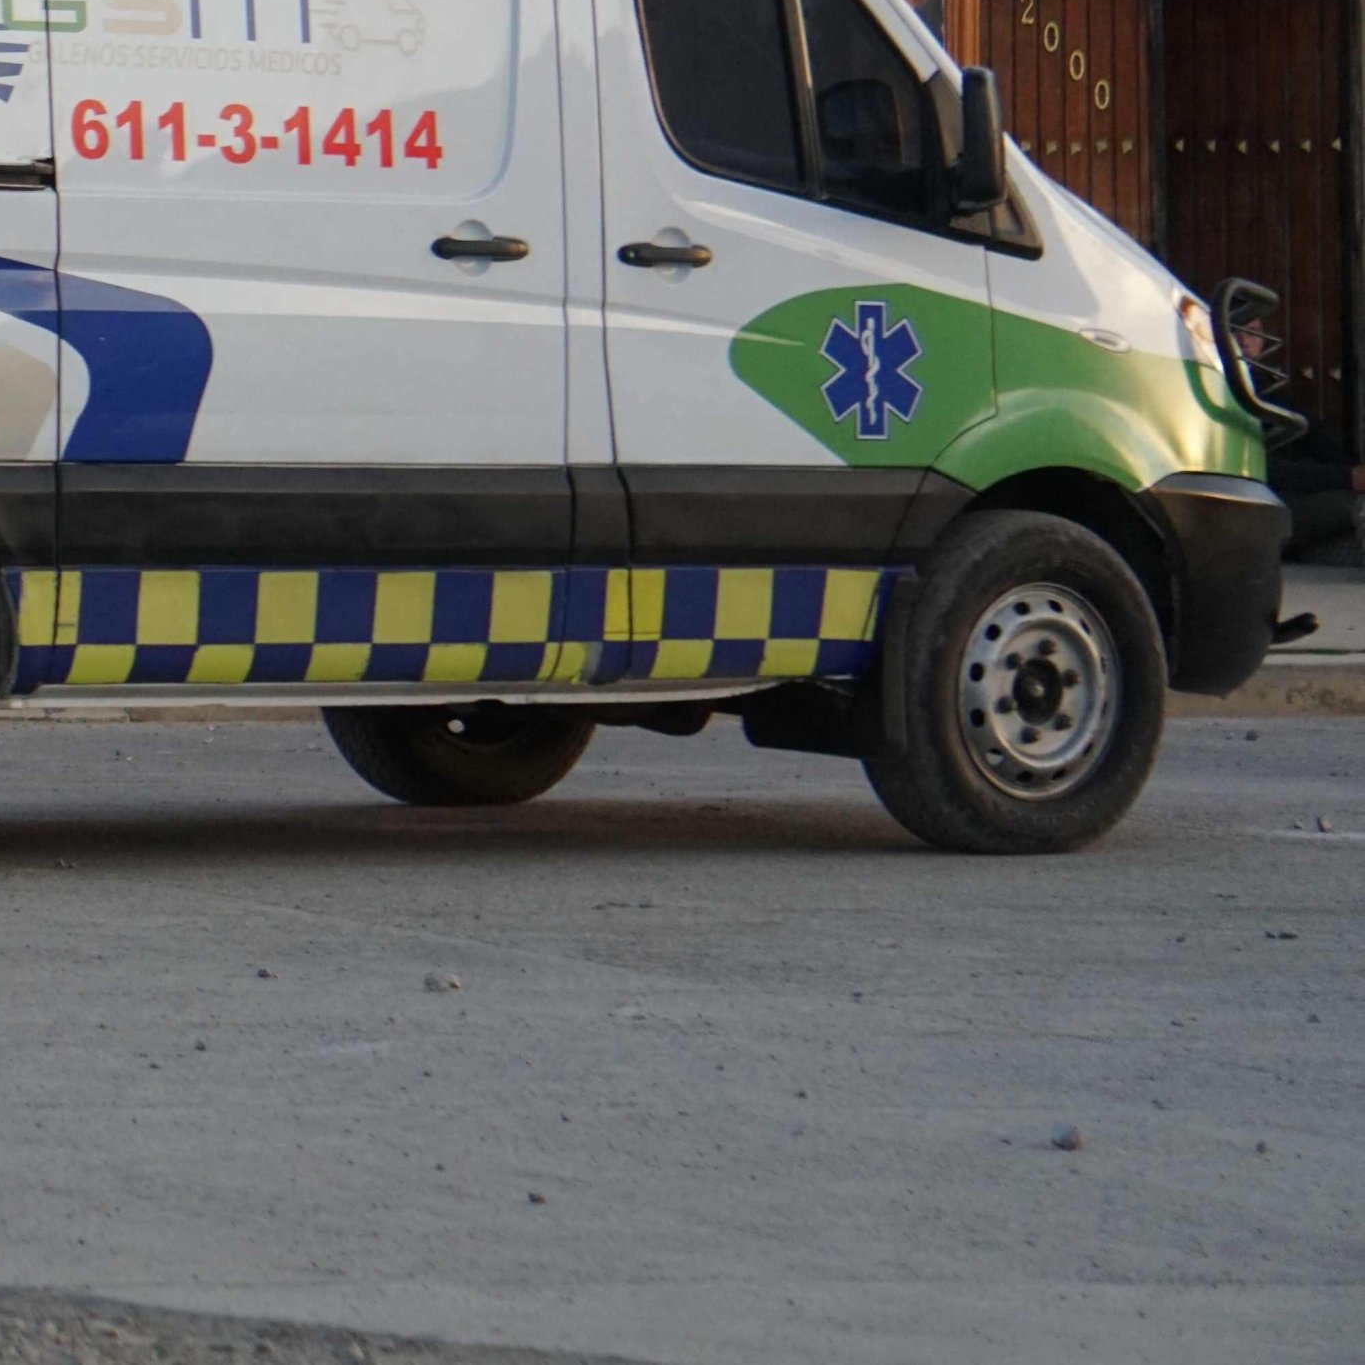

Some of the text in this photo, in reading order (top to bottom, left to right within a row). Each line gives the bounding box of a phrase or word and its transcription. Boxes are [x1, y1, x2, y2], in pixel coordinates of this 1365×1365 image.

[133, 43, 242, 72] SERVICIOS
[247, 48, 343, 77] MEDICOS
[70, 98, 445, 171] 611-3-1414
